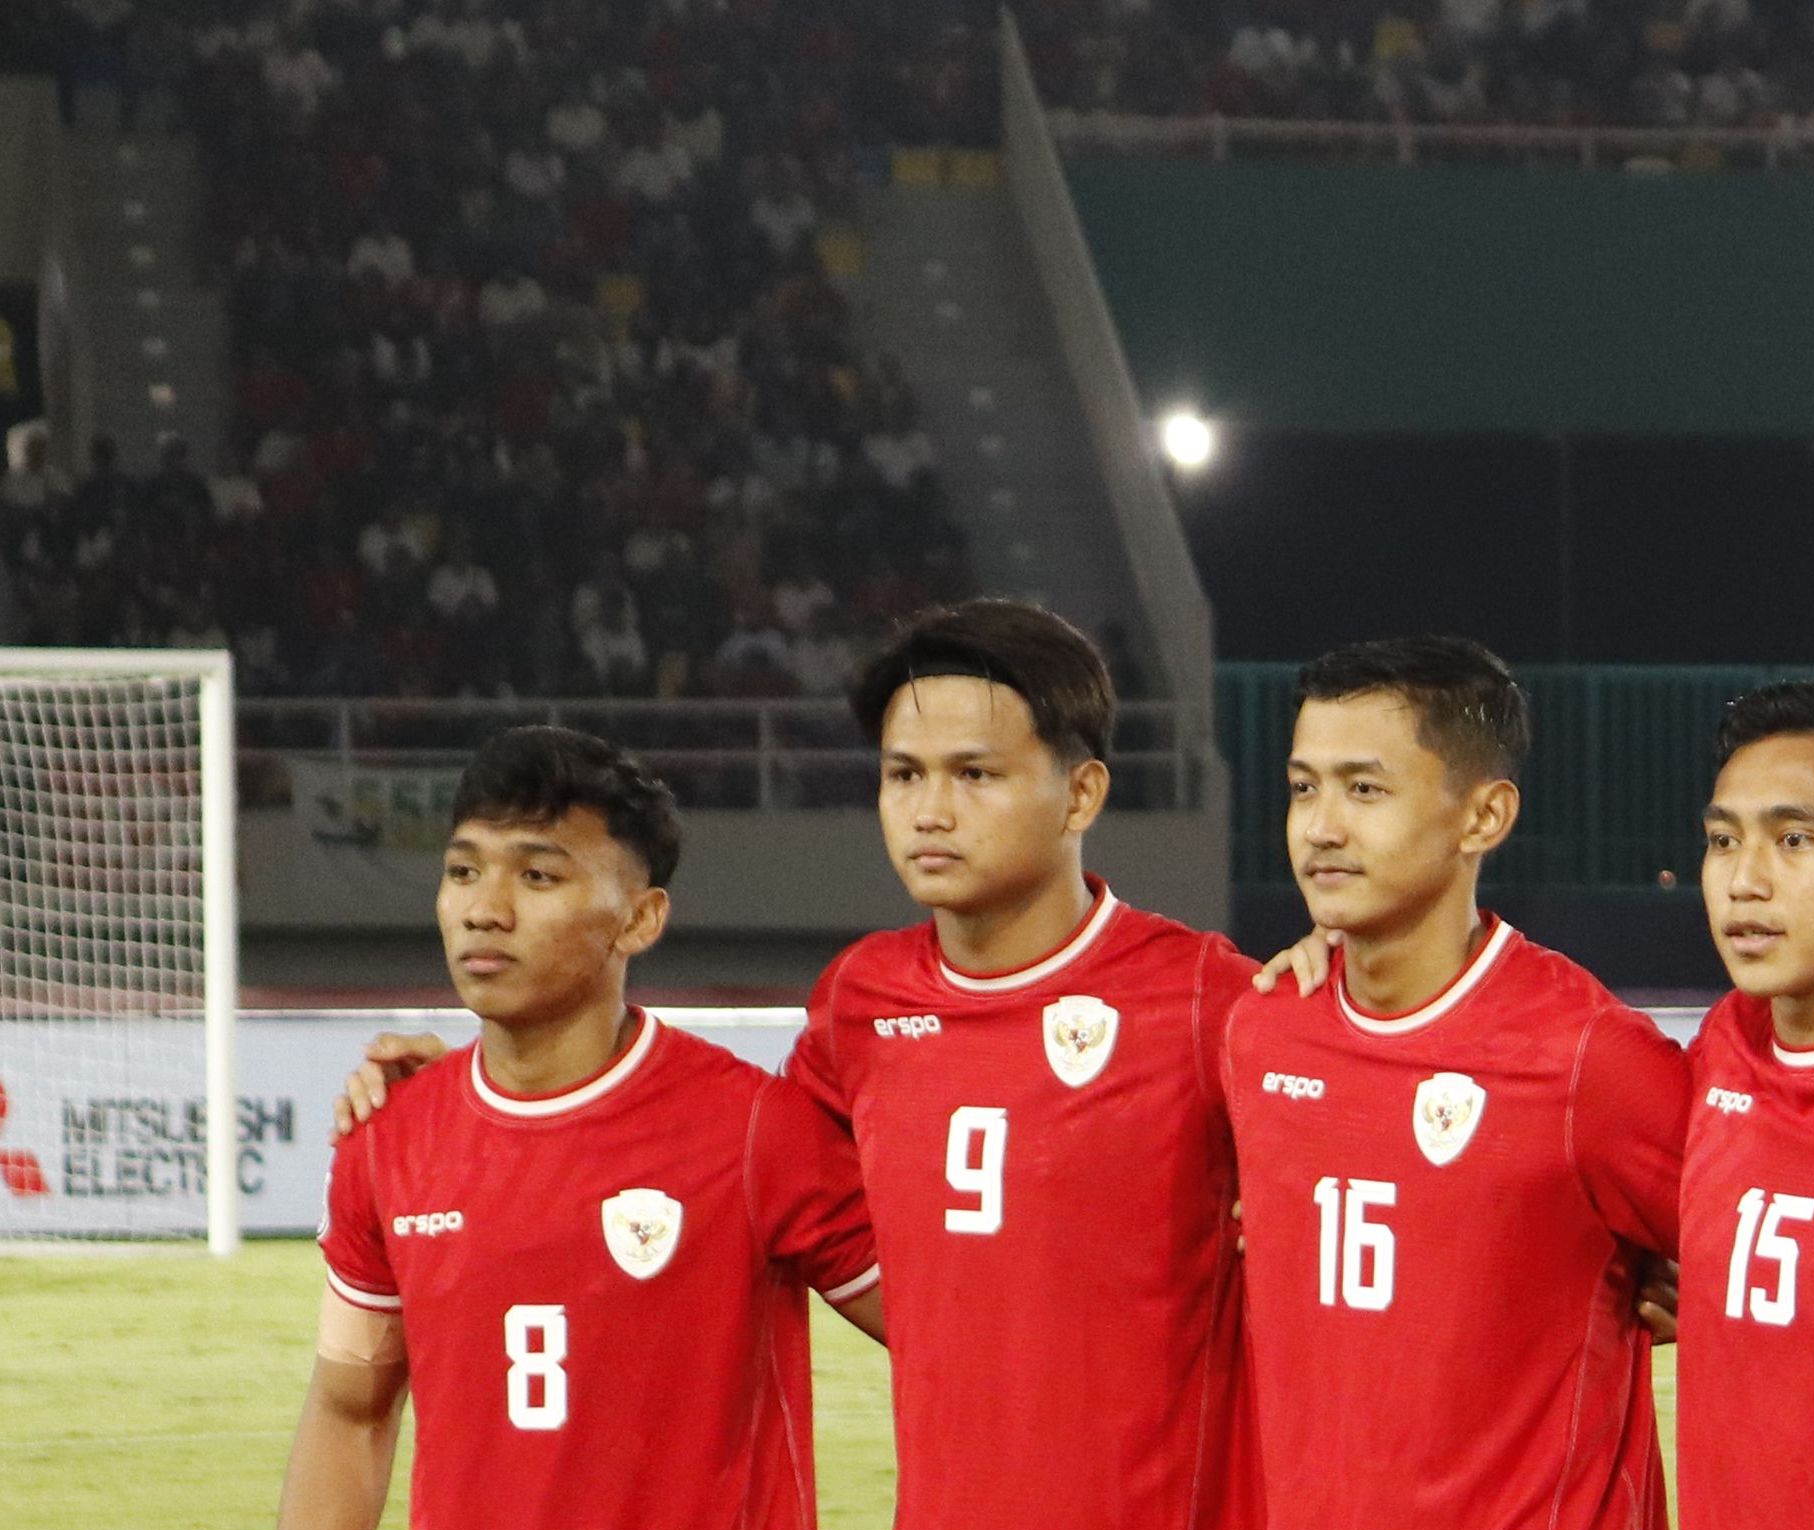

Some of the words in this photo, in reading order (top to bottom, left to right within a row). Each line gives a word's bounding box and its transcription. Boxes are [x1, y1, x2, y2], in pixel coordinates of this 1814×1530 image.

[873, 1013, 942, 1041] erspo
[1261, 1071, 1326, 1101] erspo
[1705, 1086, 1755, 1117] erspo
[62, 1149, 264, 1196] ELECTRC
[944, 1105, 1009, 1235] 9
[392, 1209, 465, 1238] erspo
[1313, 1176, 1397, 1312] 16
[504, 1304, 568, 1431] 8
